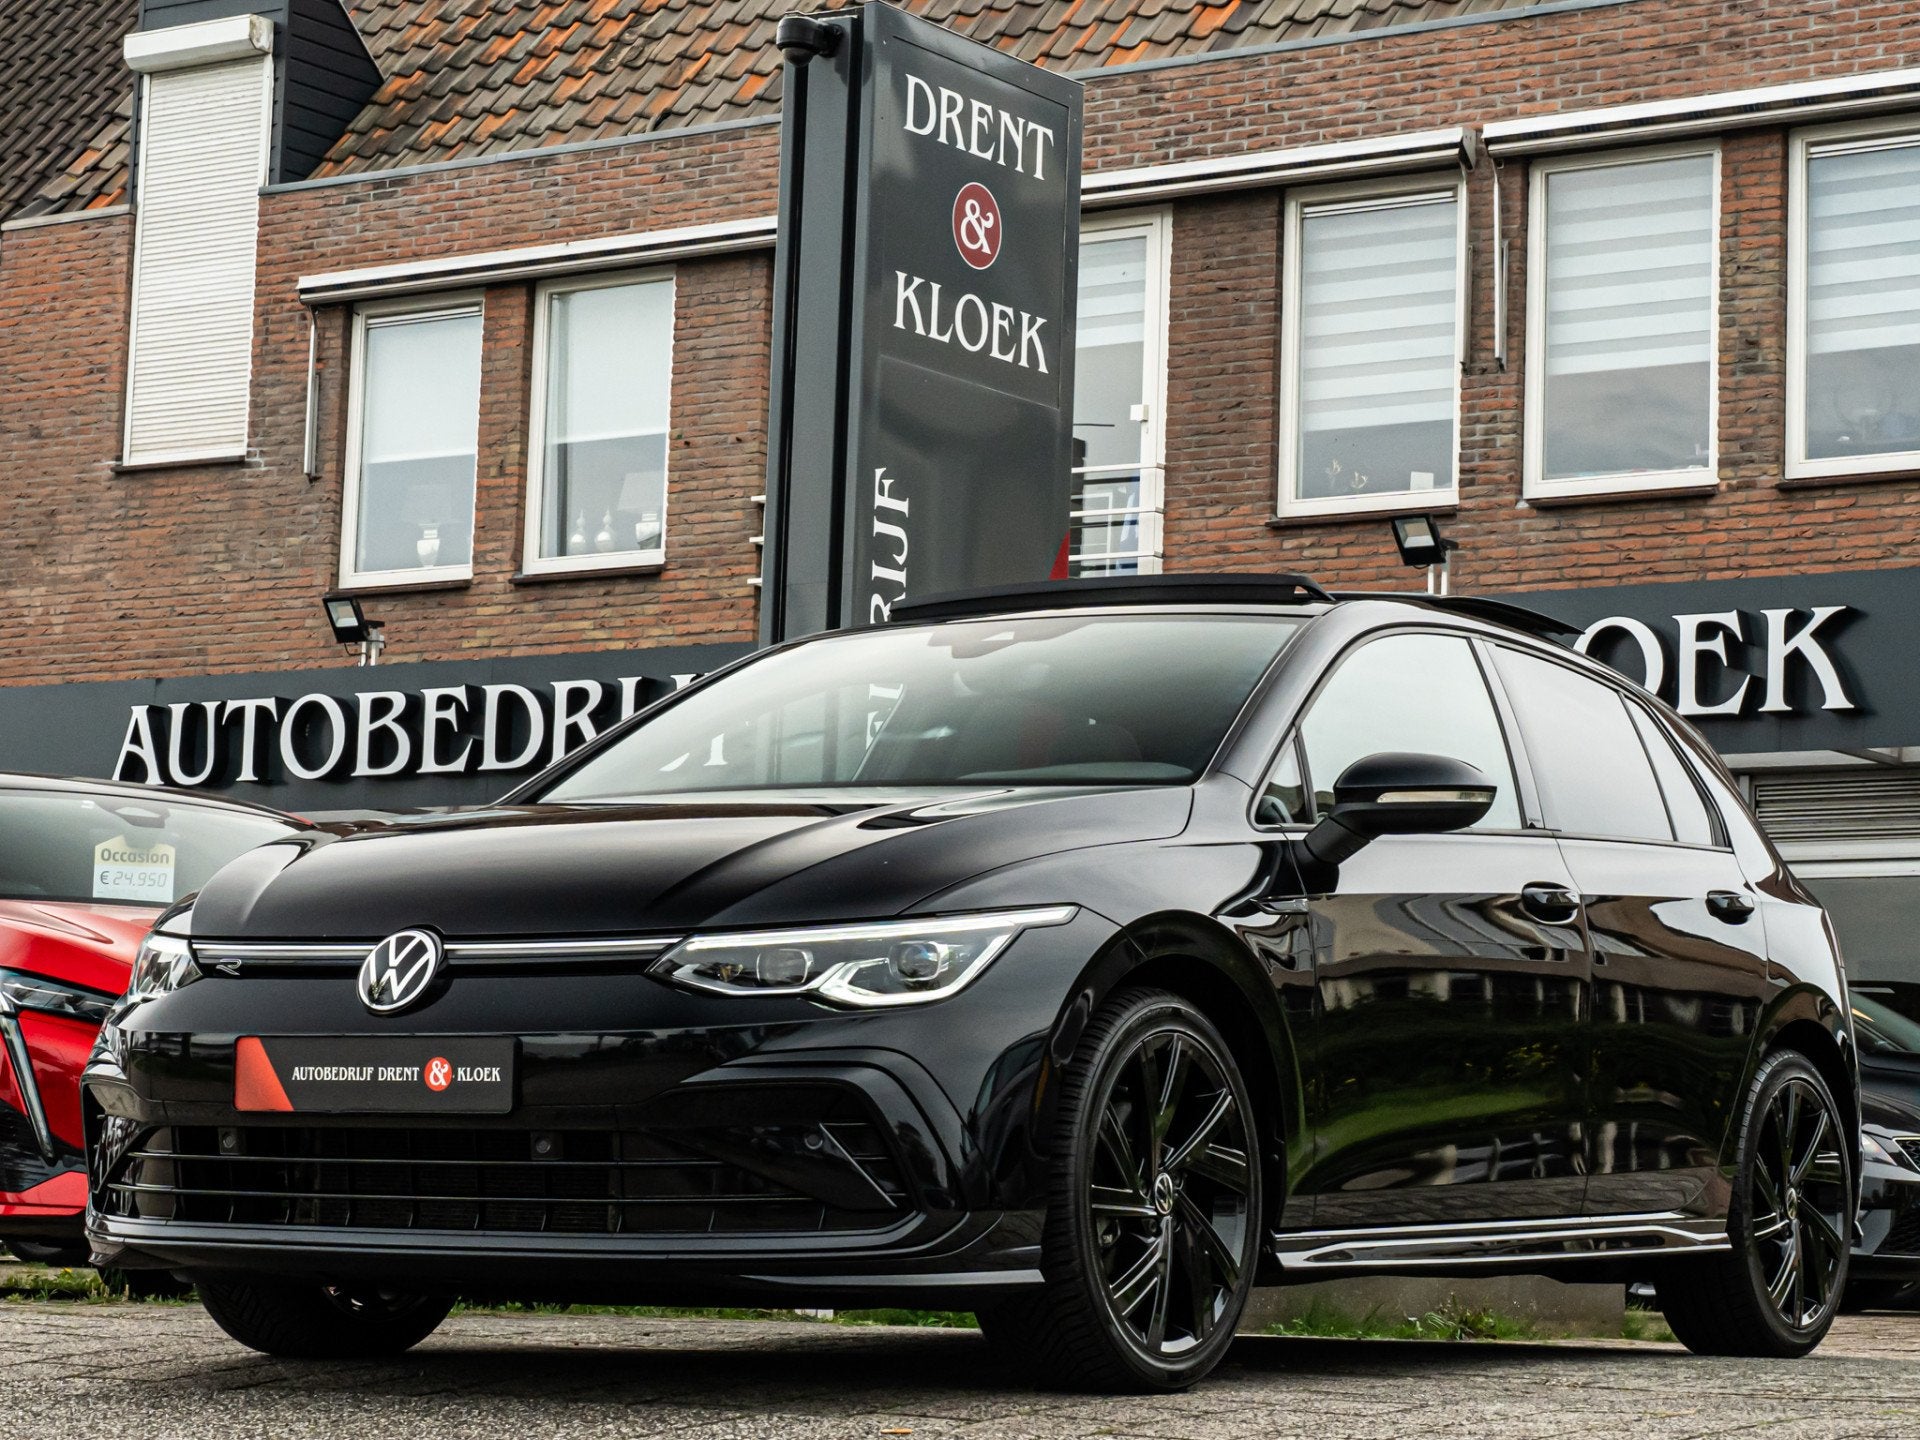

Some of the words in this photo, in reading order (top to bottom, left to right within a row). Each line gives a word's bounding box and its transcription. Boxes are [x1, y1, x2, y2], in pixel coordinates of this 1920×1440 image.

[903, 73, 1054, 181] DRENT
[960, 198, 995, 255] &
[893, 270, 1049, 374] KLOEK
[112, 673, 728, 786] AUTOBEDRI
[100, 871, 110, 885] €
[113, 871, 167, 888] 24.950
[101, 848, 169, 864] Occasion
[291, 1066, 375, 1081] AUTOBEDRIJF
[378, 1067, 420, 1081] DRENT
[429, 1061, 449, 1086] &
[457, 1067, 501, 1081] KLOEK
